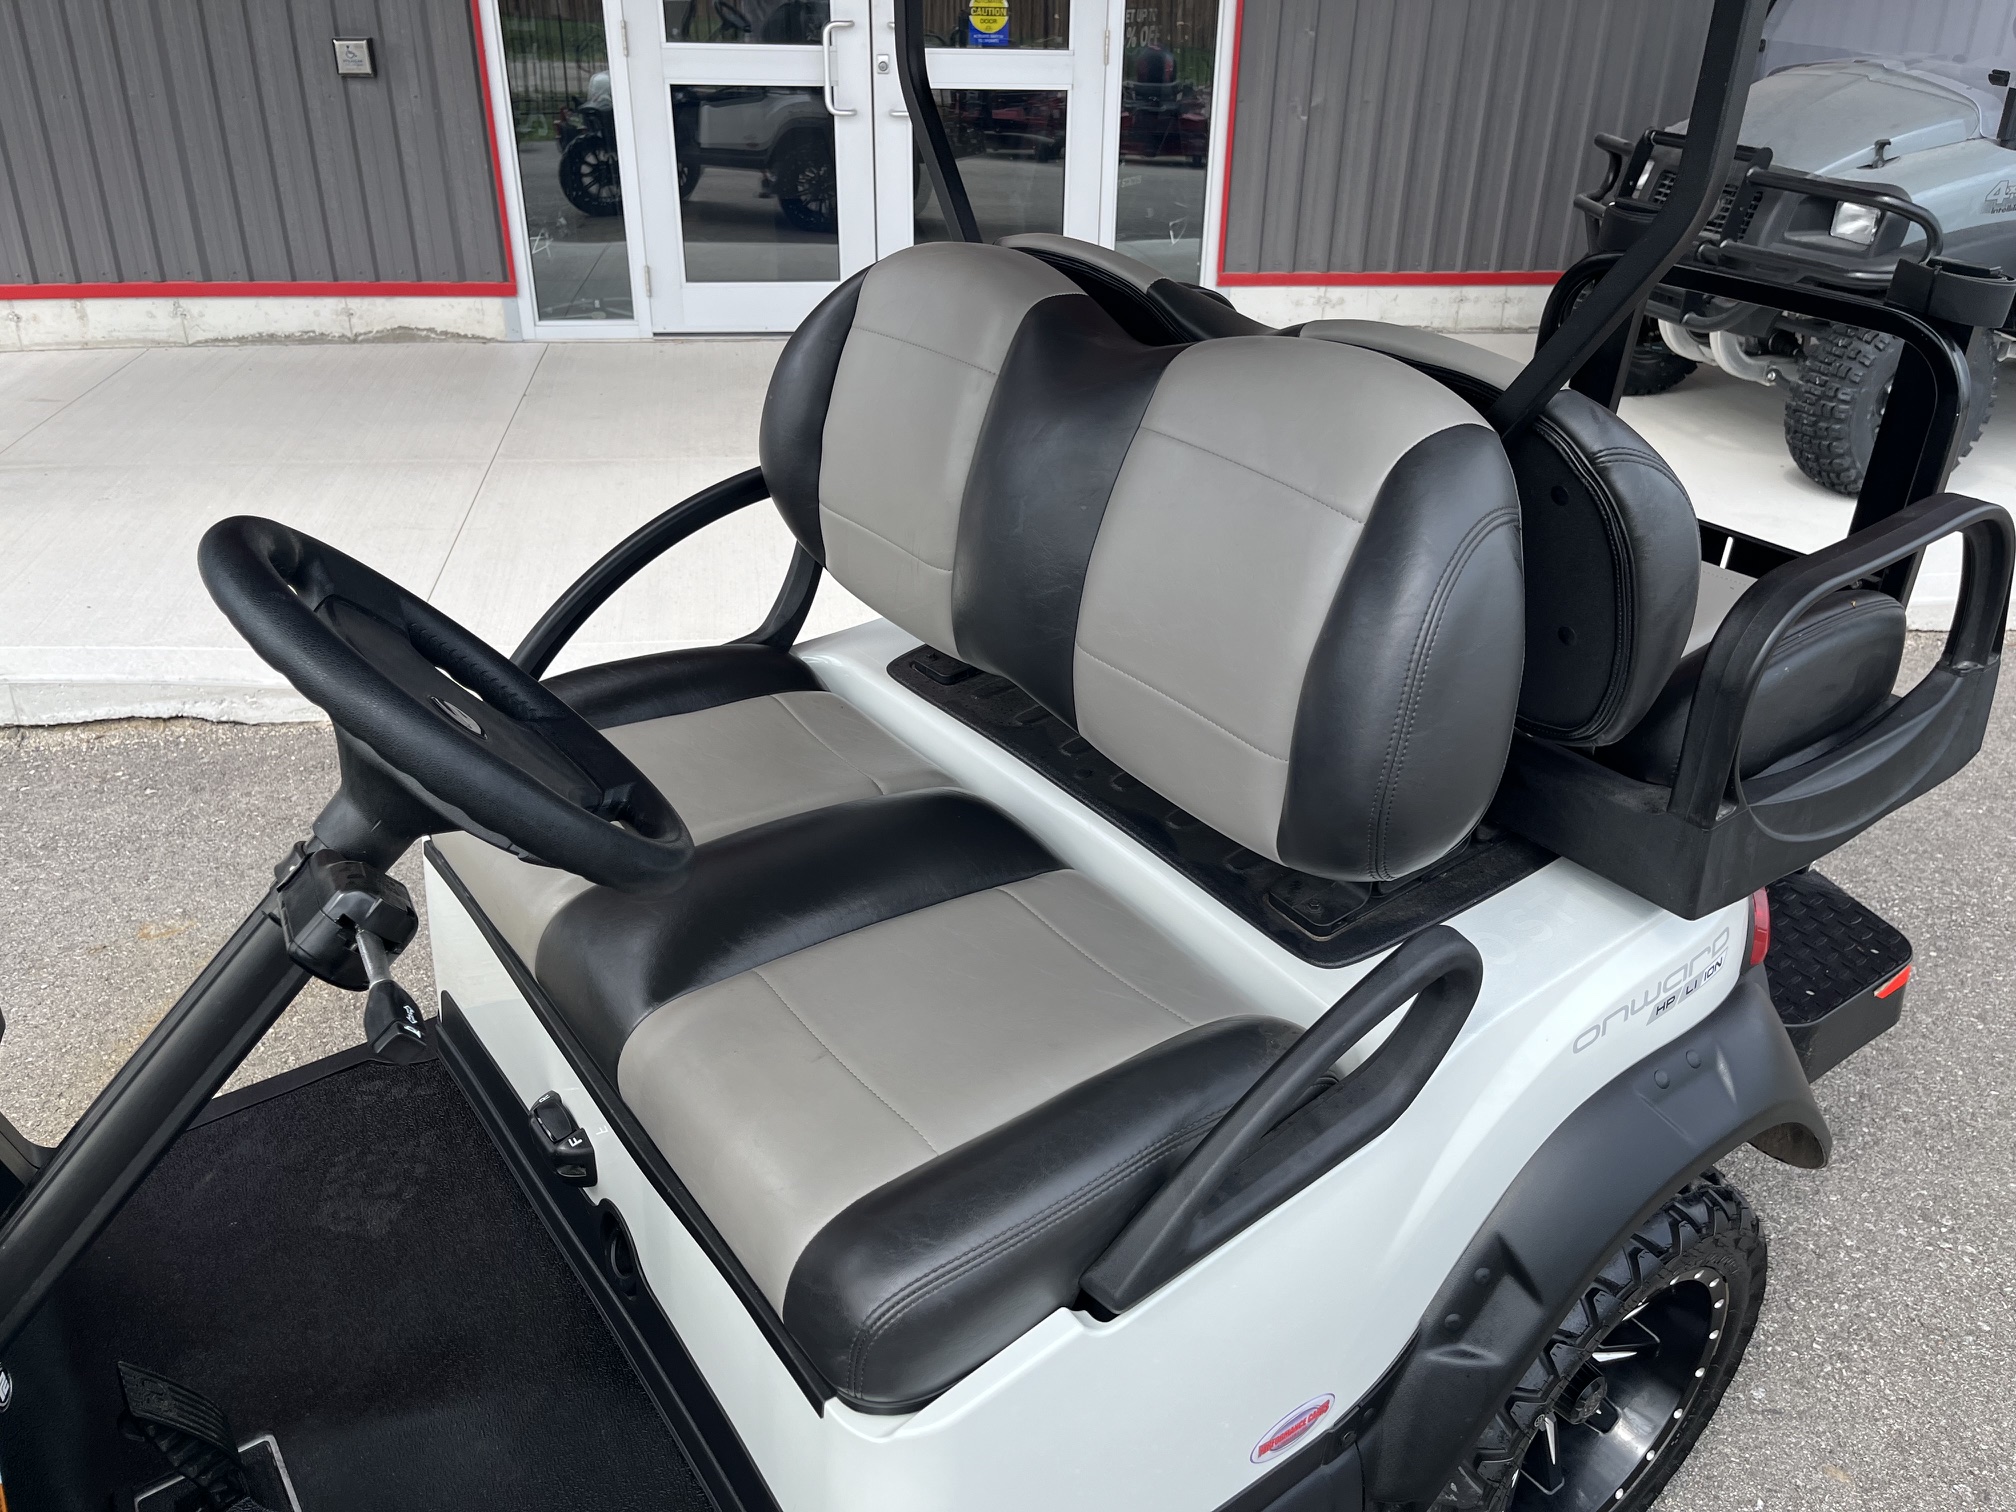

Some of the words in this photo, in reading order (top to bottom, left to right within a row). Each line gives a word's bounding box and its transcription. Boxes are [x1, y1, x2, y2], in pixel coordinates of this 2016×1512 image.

[971, 7, 1007, 15] CAUTION
[1655, 995, 1677, 1016] HP
[1685, 979, 1699, 996] LI
[1703, 956, 1723, 982] ION
[568, 1137, 583, 1147] F
